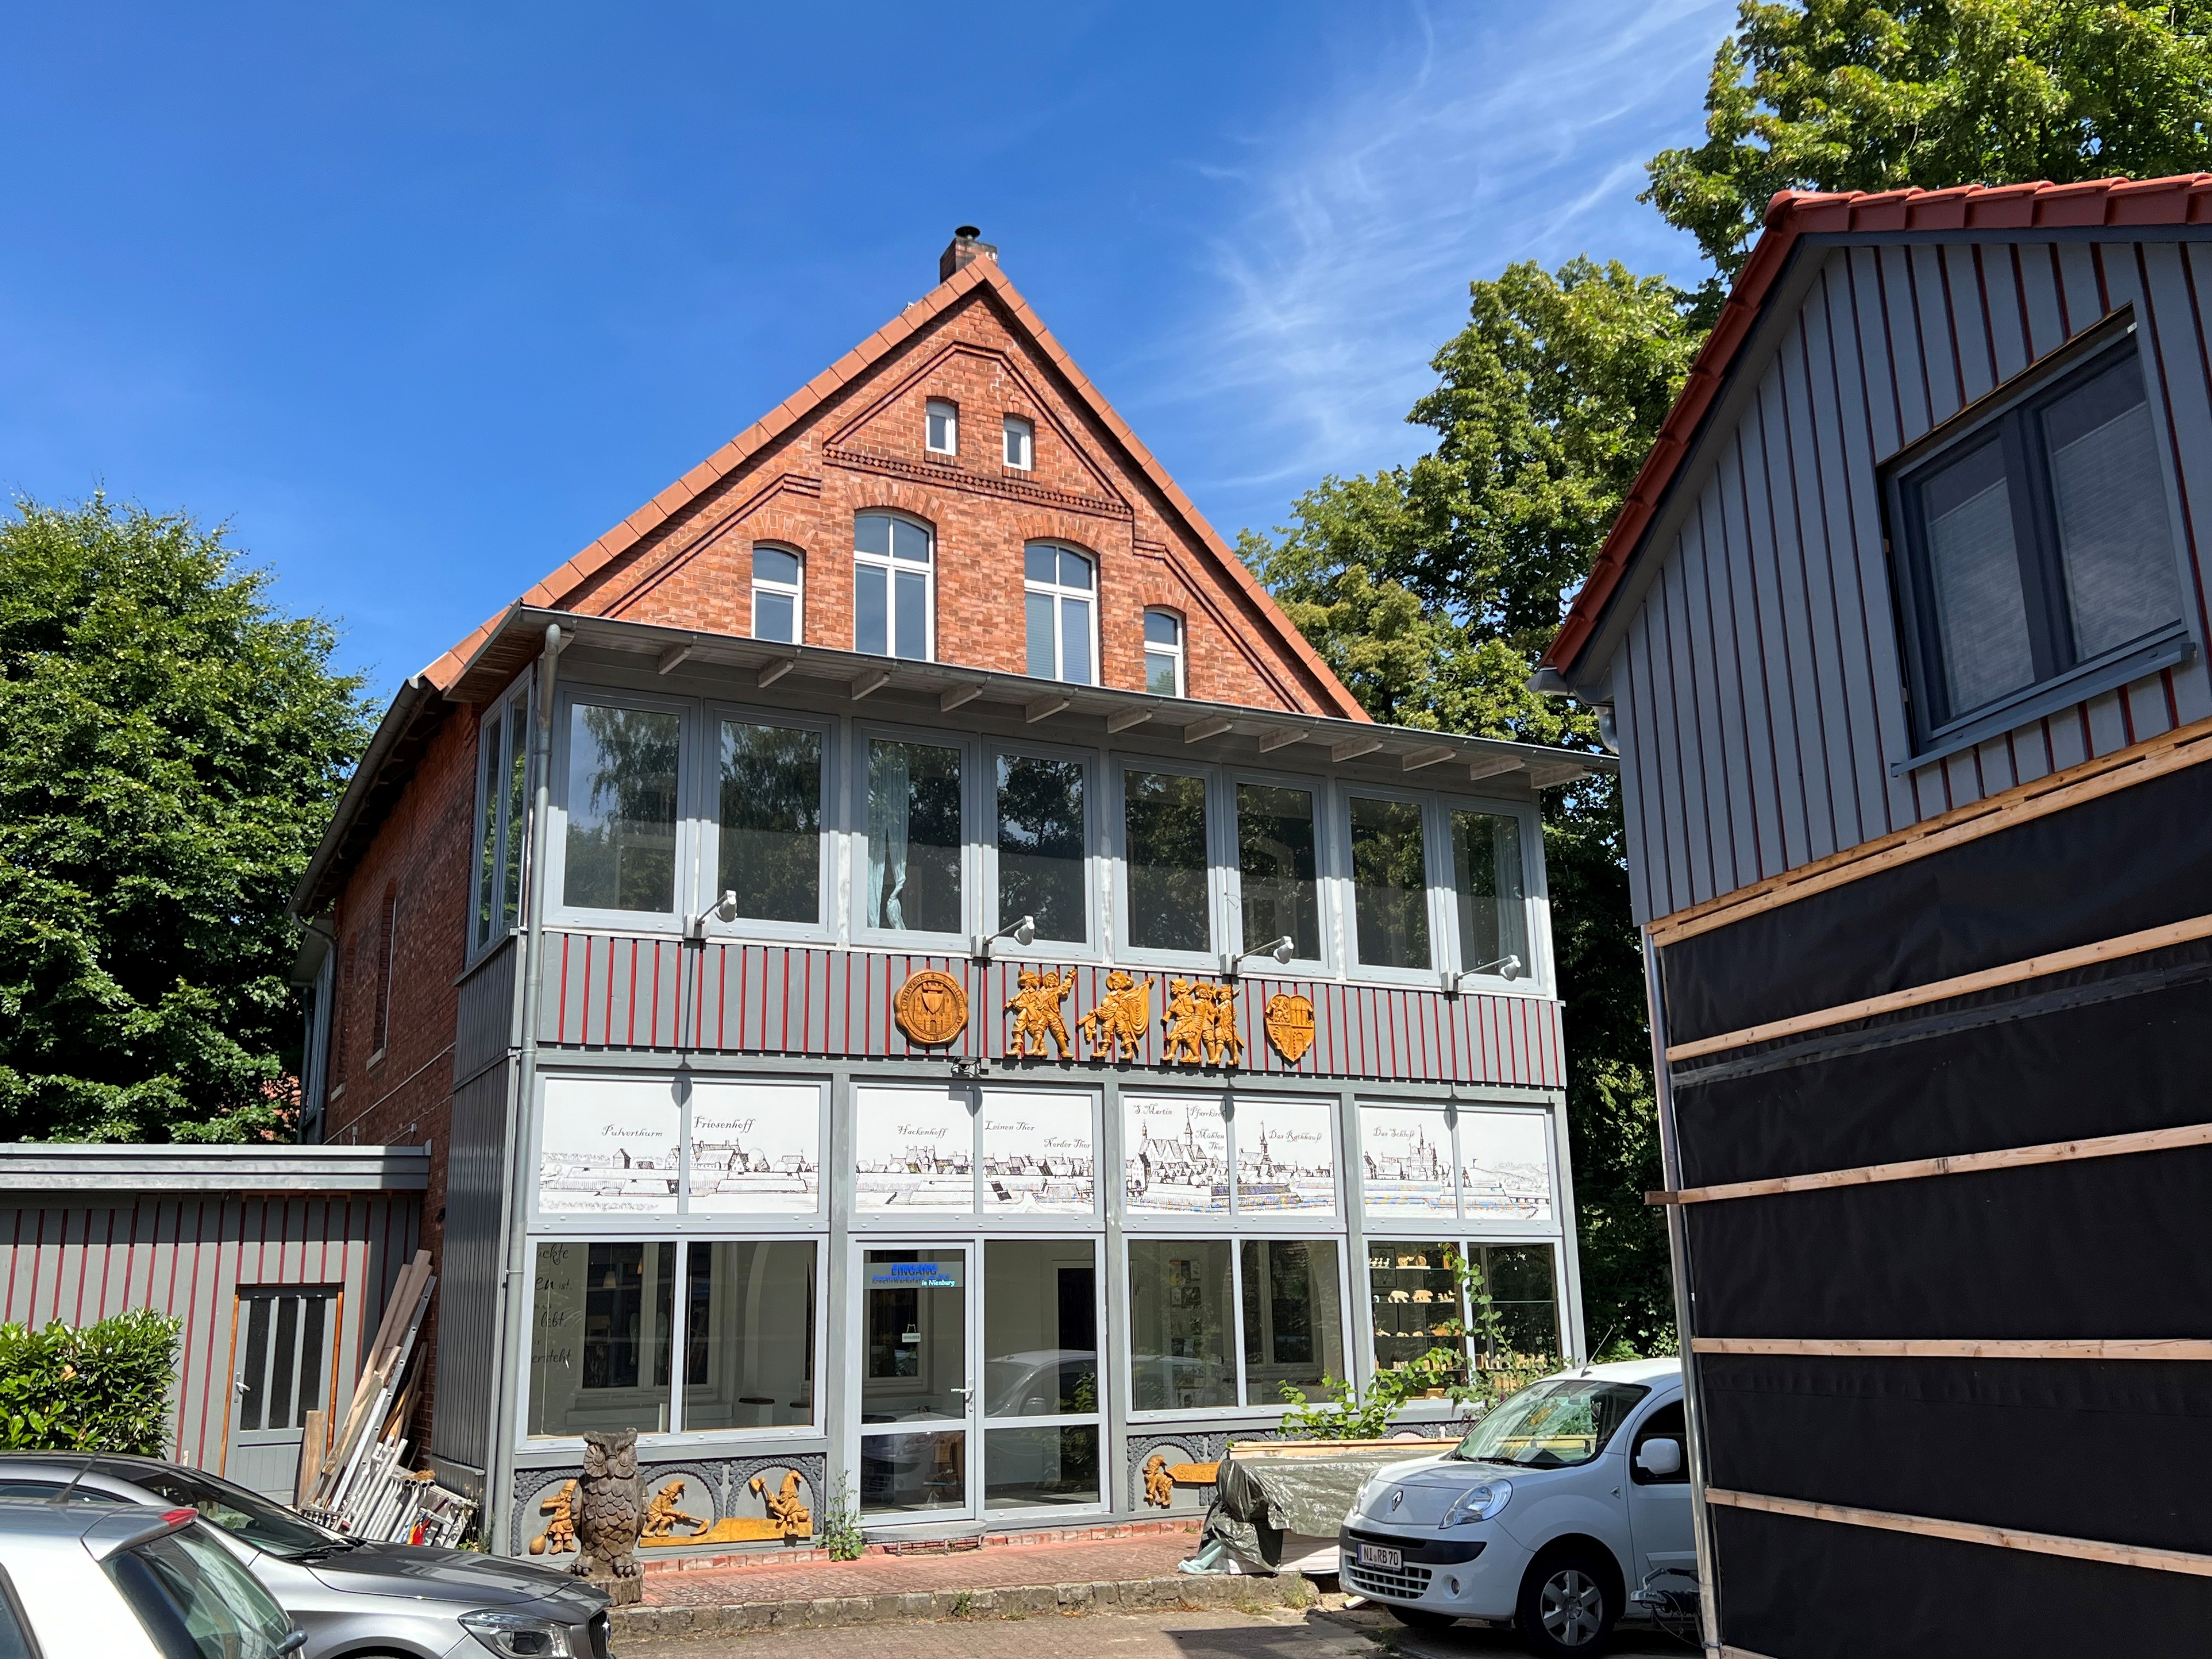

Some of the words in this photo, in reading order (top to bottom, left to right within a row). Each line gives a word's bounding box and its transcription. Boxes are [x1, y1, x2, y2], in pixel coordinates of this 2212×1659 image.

[1143, 1103, 1172, 1115] Martin
[694, 1115, 756, 1133] Friesenhoff
[1015, 1121, 1035, 1131] Thor
[601, 1124, 663, 1137] Pulverthurm
[898, 1124, 949, 1138] Hackenhoff
[1269, 1128, 1284, 1139] Das
[1373, 1126, 1387, 1136] Das
[1043, 1137, 1071, 1148] Norder
[1073, 1139, 1091, 1148] Thor
[891, 1263, 938, 1276] EINGANG
[1364, 1547, 1373, 1561] NI
